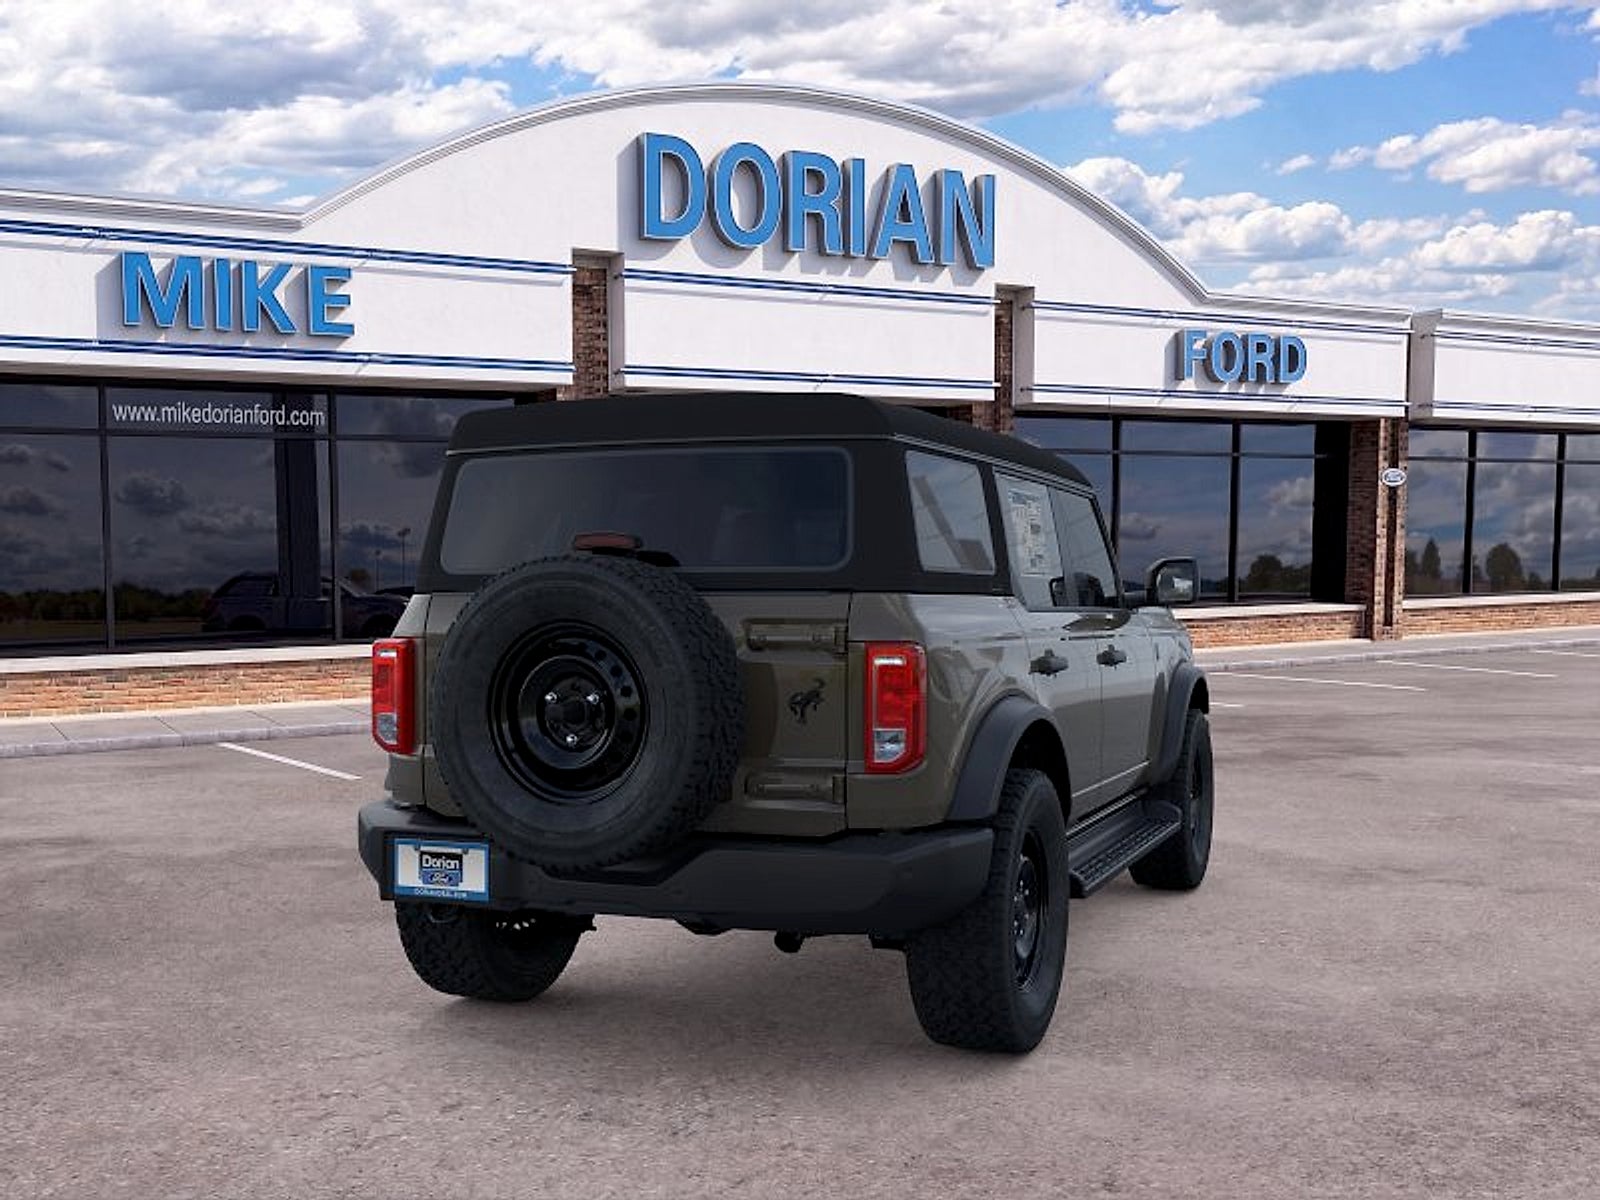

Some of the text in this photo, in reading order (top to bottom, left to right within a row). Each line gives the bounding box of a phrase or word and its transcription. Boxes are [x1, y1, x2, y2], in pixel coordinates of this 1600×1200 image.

[640, 132, 996, 270] DORIAN
[122, 251, 355, 337] MIKE
[1178, 328, 1308, 384] FORD
[112, 402, 325, 426] www.mikedorianford.com
[422, 854, 460, 870] Dorian
